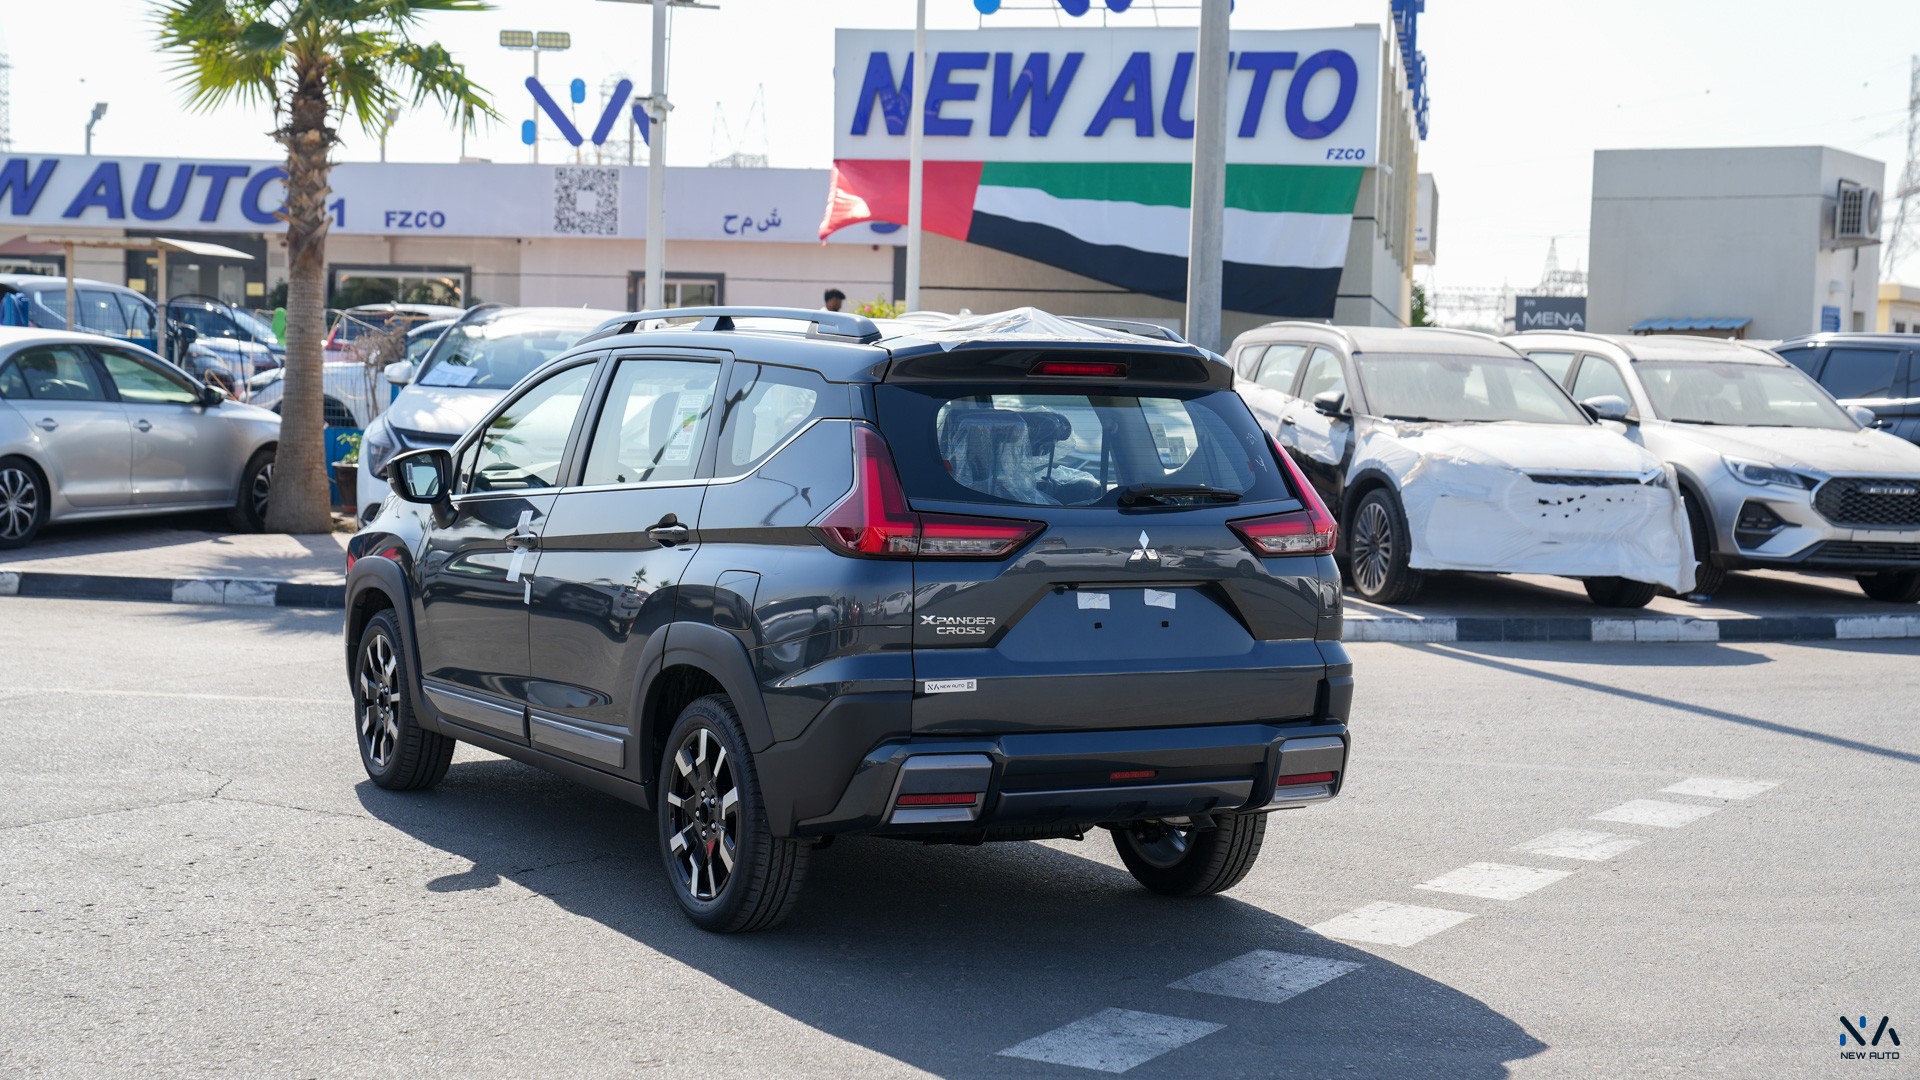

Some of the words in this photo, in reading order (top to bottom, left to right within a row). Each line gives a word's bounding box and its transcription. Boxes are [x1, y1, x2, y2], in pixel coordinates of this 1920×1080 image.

[850, 51, 1085, 137] NEW
[1084, 49, 1359, 139] AUTO
[1326, 148, 1366, 160] FZCO
[61, 161, 289, 224] AUTO
[385, 211, 446, 228] FZCO
[1523, 311, 1584, 326] MENA
[920, 615, 996, 625] XPANDER
[936, 626, 986, 635] CROSS
